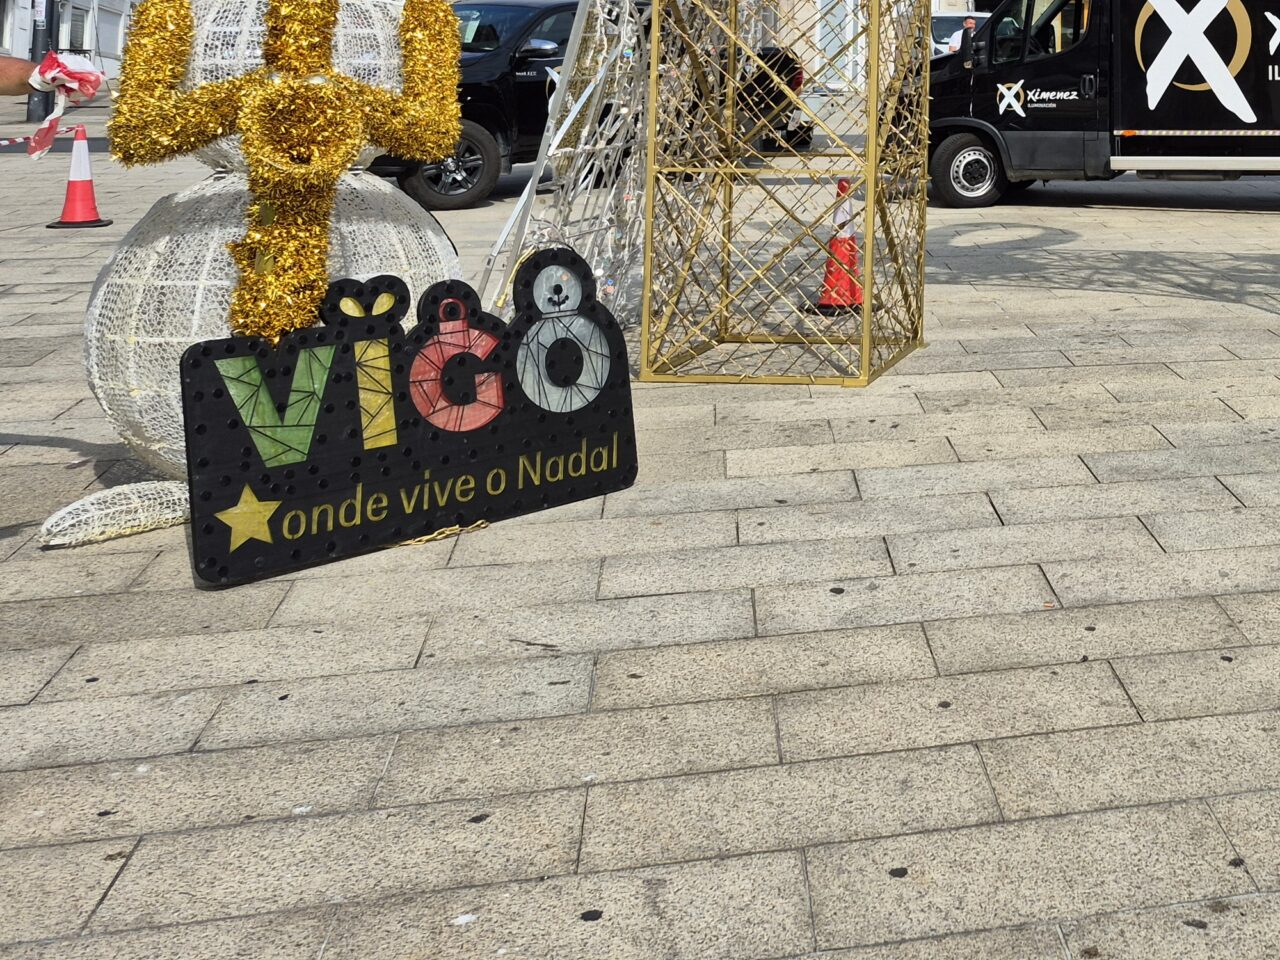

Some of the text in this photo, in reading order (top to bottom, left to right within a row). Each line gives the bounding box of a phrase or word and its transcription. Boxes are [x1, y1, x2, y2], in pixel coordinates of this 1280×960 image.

[1026, 88, 1079, 102] Ximenez
[281, 431, 620, 541] onde vive o Nadal
